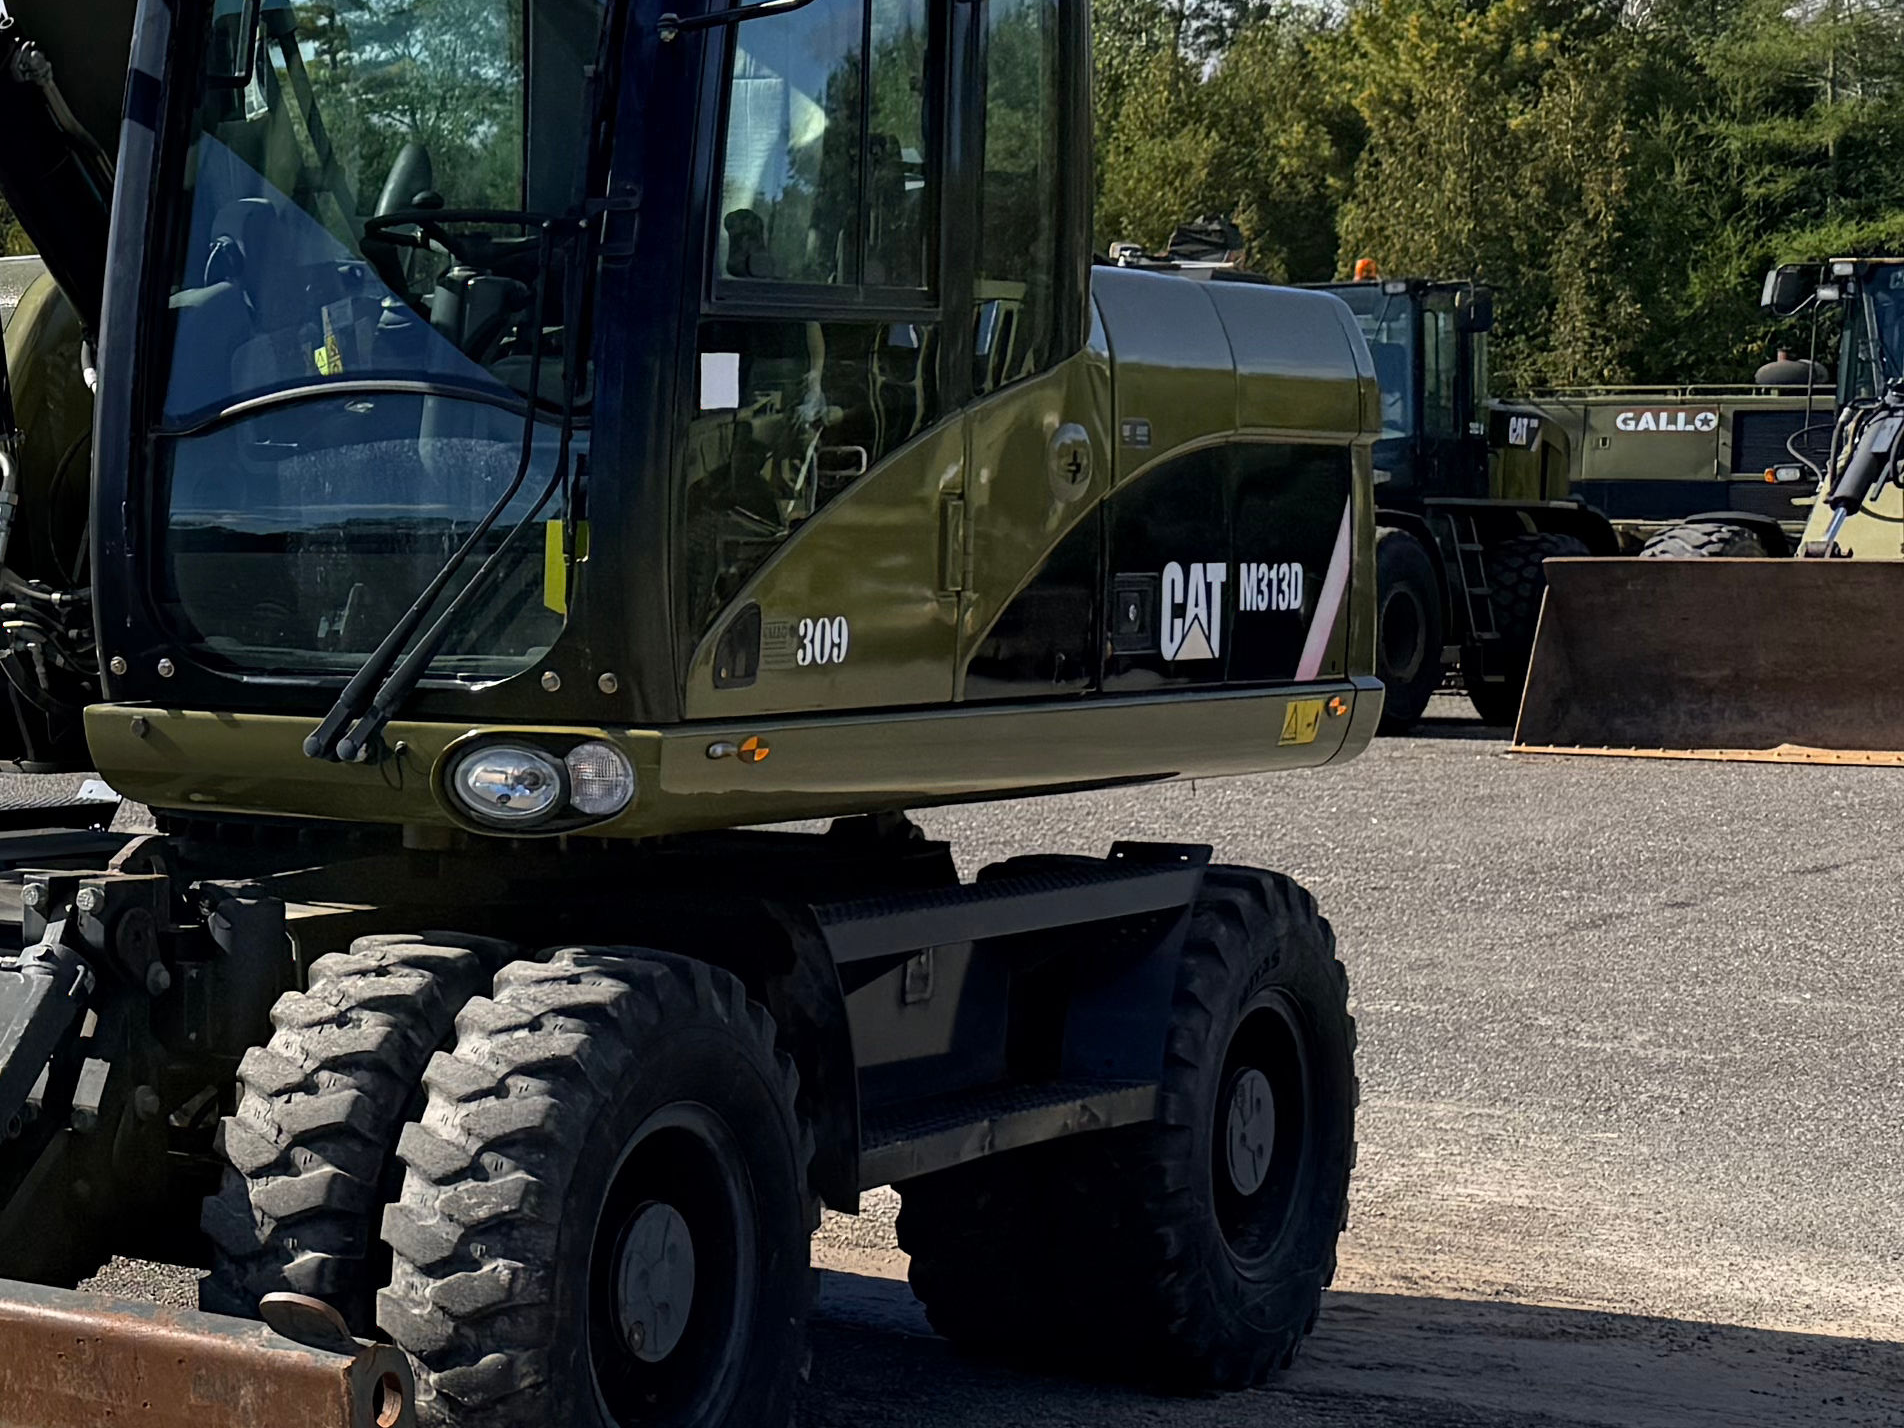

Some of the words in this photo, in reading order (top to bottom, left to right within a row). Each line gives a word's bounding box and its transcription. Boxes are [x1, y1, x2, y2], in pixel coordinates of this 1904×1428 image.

[1509, 417, 1528, 444] CAT
[1616, 411, 1718, 431] GALLO
[1161, 561, 1226, 661] CAT
[1240, 562, 1303, 611] M313D
[797, 616, 848, 665] 309
